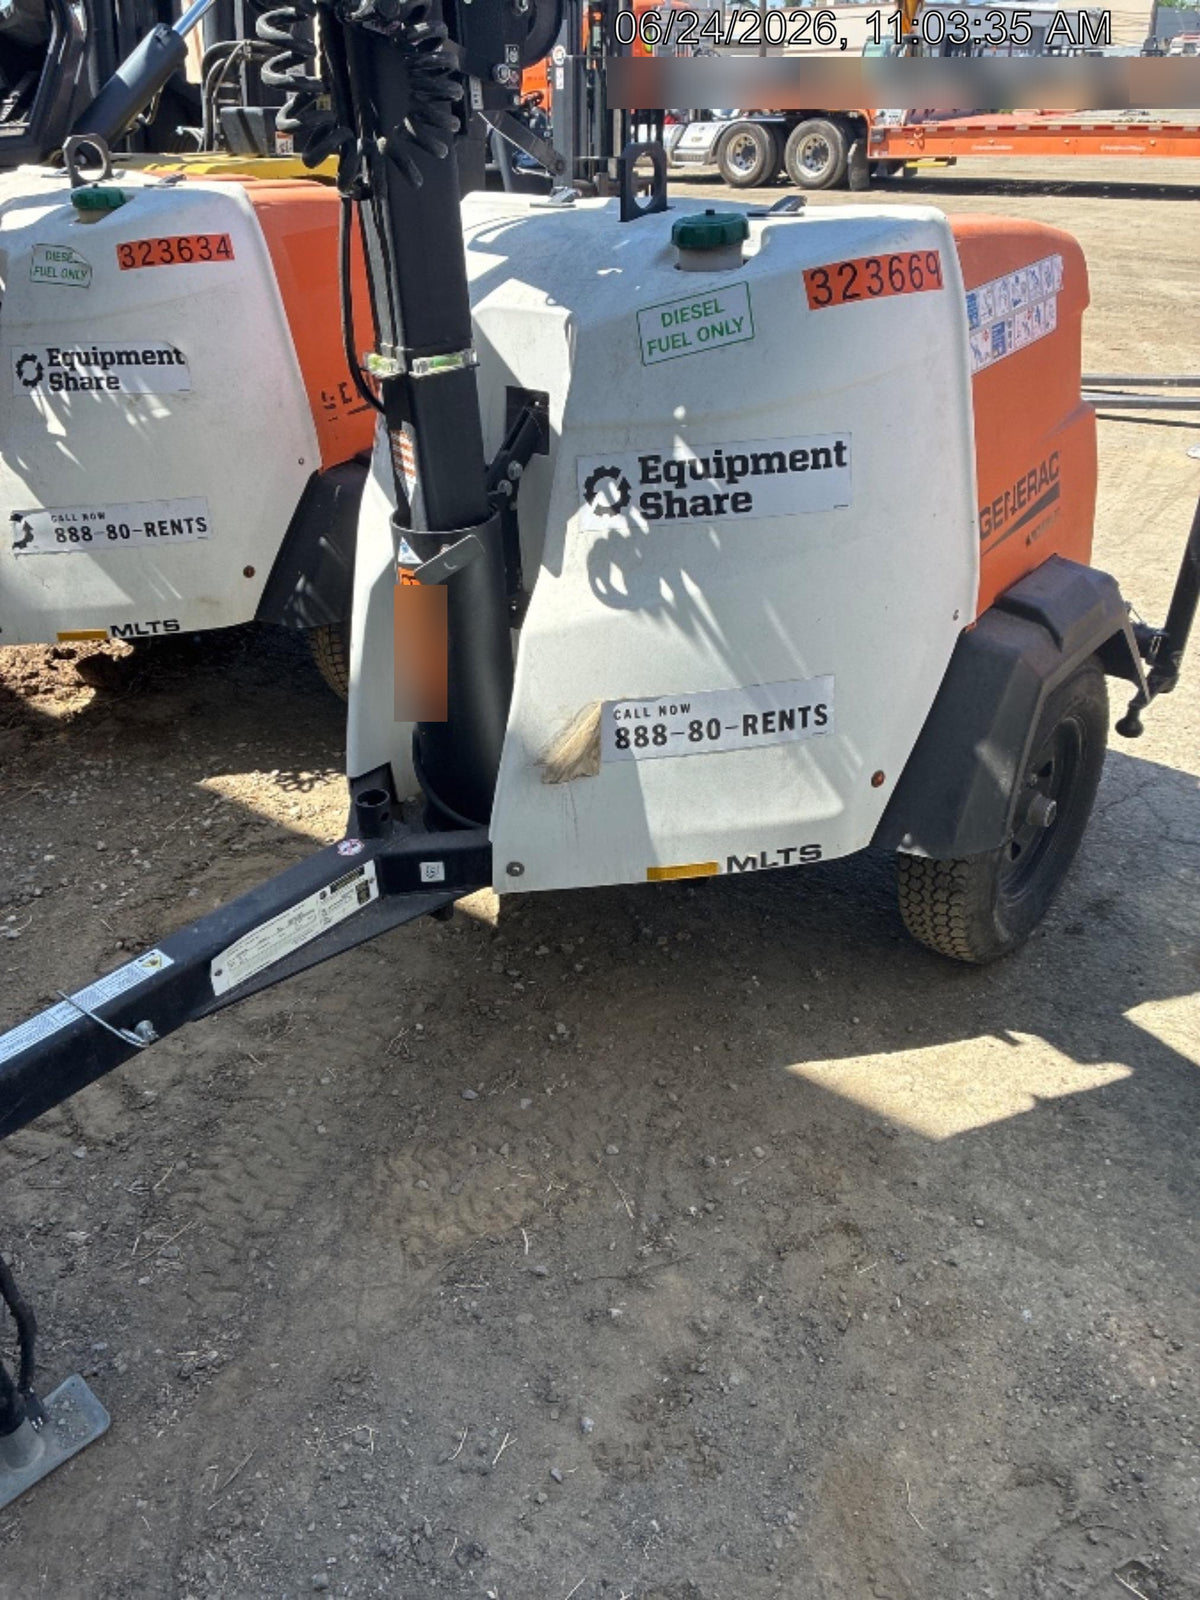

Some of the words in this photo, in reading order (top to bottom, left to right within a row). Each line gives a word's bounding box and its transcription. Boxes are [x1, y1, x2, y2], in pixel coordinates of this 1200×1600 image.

[119, 235, 231, 267] 323634
[34, 266, 58, 278] FUEL
[61, 268, 88, 280] ONLY
[809, 252, 942, 306] 323669
[660, 298, 726, 328] DIESEL
[646, 331, 692, 356] FUEL
[696, 316, 744, 342] ONLY
[46, 347, 185, 371] Equipment
[50, 372, 120, 392] Share
[638, 440, 848, 489] Equipment
[639, 489, 753, 520] Share
[54, 516, 207, 543] 888-80-RENTS
[110, 619, 181, 637] MLTS
[613, 707, 652, 721] CALL
[658, 703, 692, 717] NOW
[614, 704, 829, 750] 888-80-RENTS
[726, 844, 823, 873] MLTS
